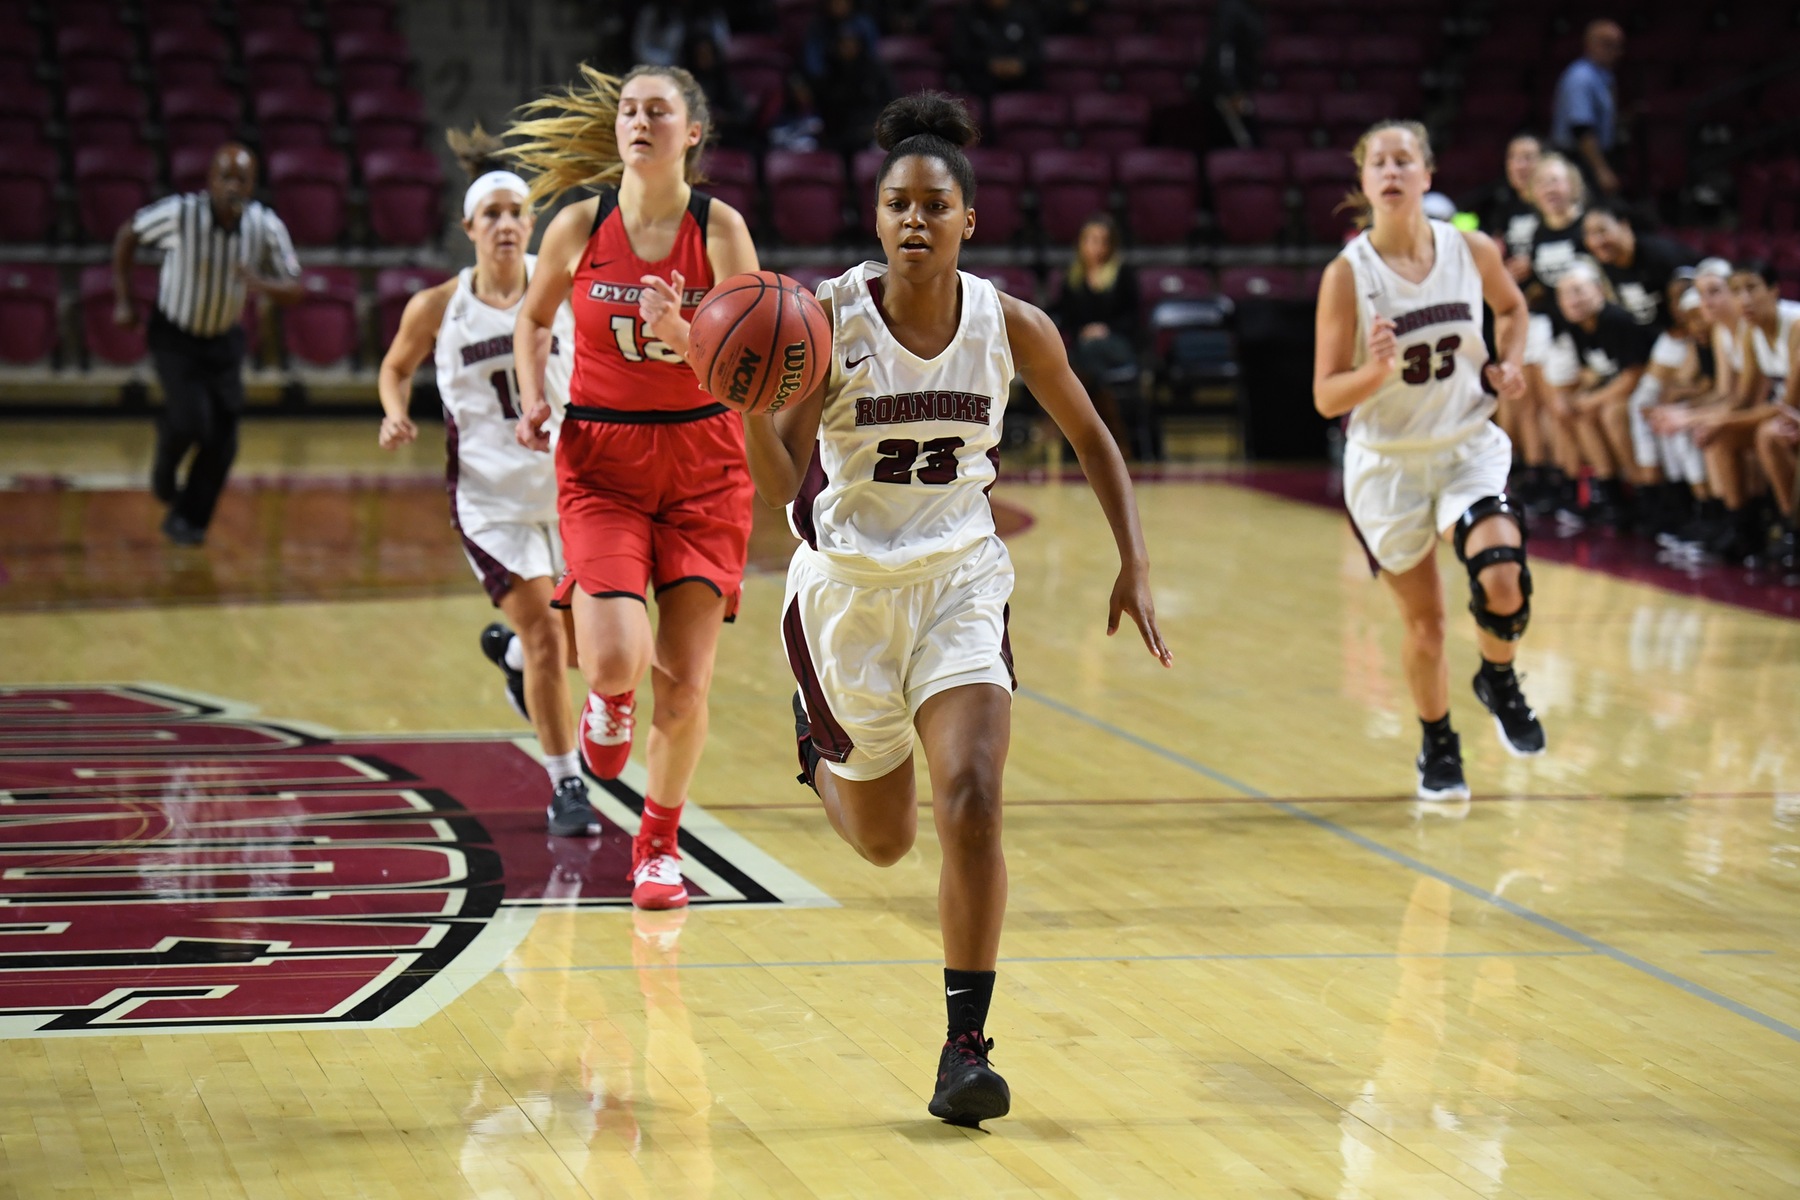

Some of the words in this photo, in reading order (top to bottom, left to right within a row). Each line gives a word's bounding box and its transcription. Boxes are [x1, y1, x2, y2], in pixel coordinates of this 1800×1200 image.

[590, 283, 705, 306] D'YOLE
[1392, 302, 1473, 337] OANOKE
[461, 333, 560, 367] ROANE
[1402, 334, 1461, 385] 33
[490, 368, 526, 420] 1
[726, 346, 762, 405] NCAA
[763, 340, 805, 414] Wilson
[855, 390, 991, 426] ROANOKE
[872, 436, 966, 485] 23
